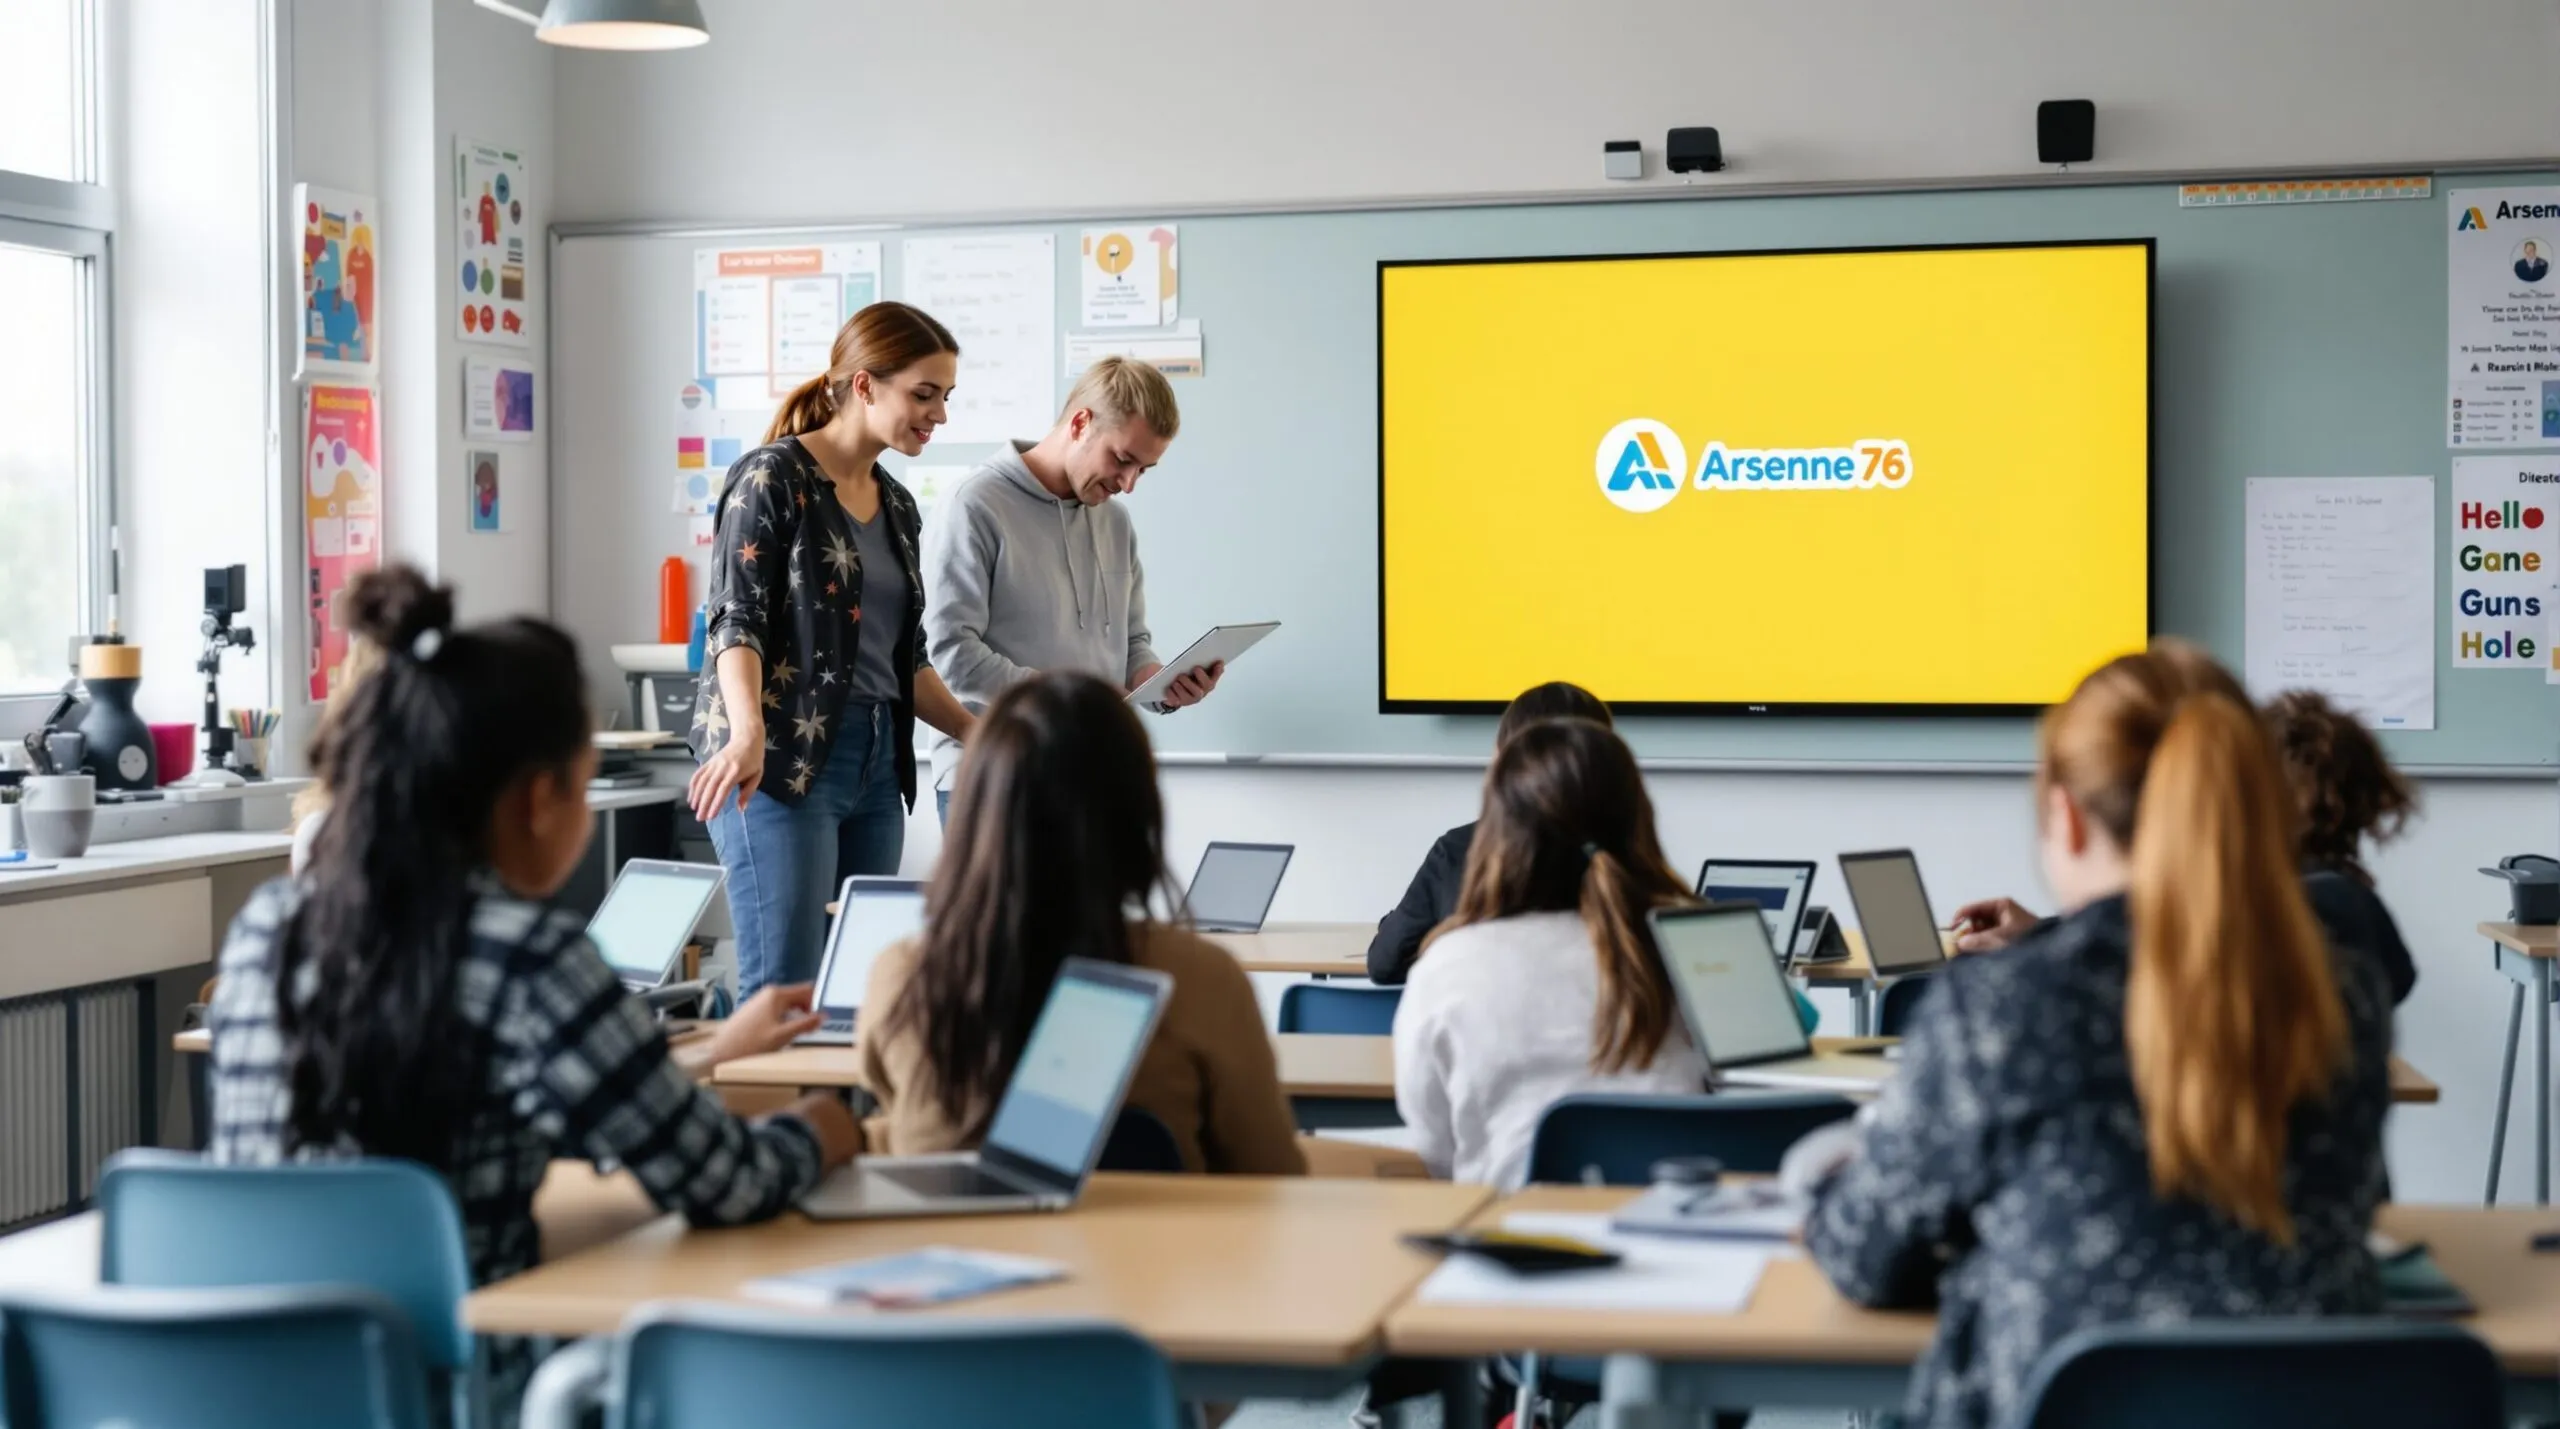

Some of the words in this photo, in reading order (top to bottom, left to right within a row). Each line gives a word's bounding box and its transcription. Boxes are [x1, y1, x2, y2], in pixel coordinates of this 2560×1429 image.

[1701, 449, 1855, 482] Arsenne
[1860, 447, 1906, 481] 76
[2461, 500, 2544, 529] Hello
[2459, 544, 2541, 573] Gane
[2459, 588, 2541, 617] Guns
[2460, 630, 2536, 659] Hole
